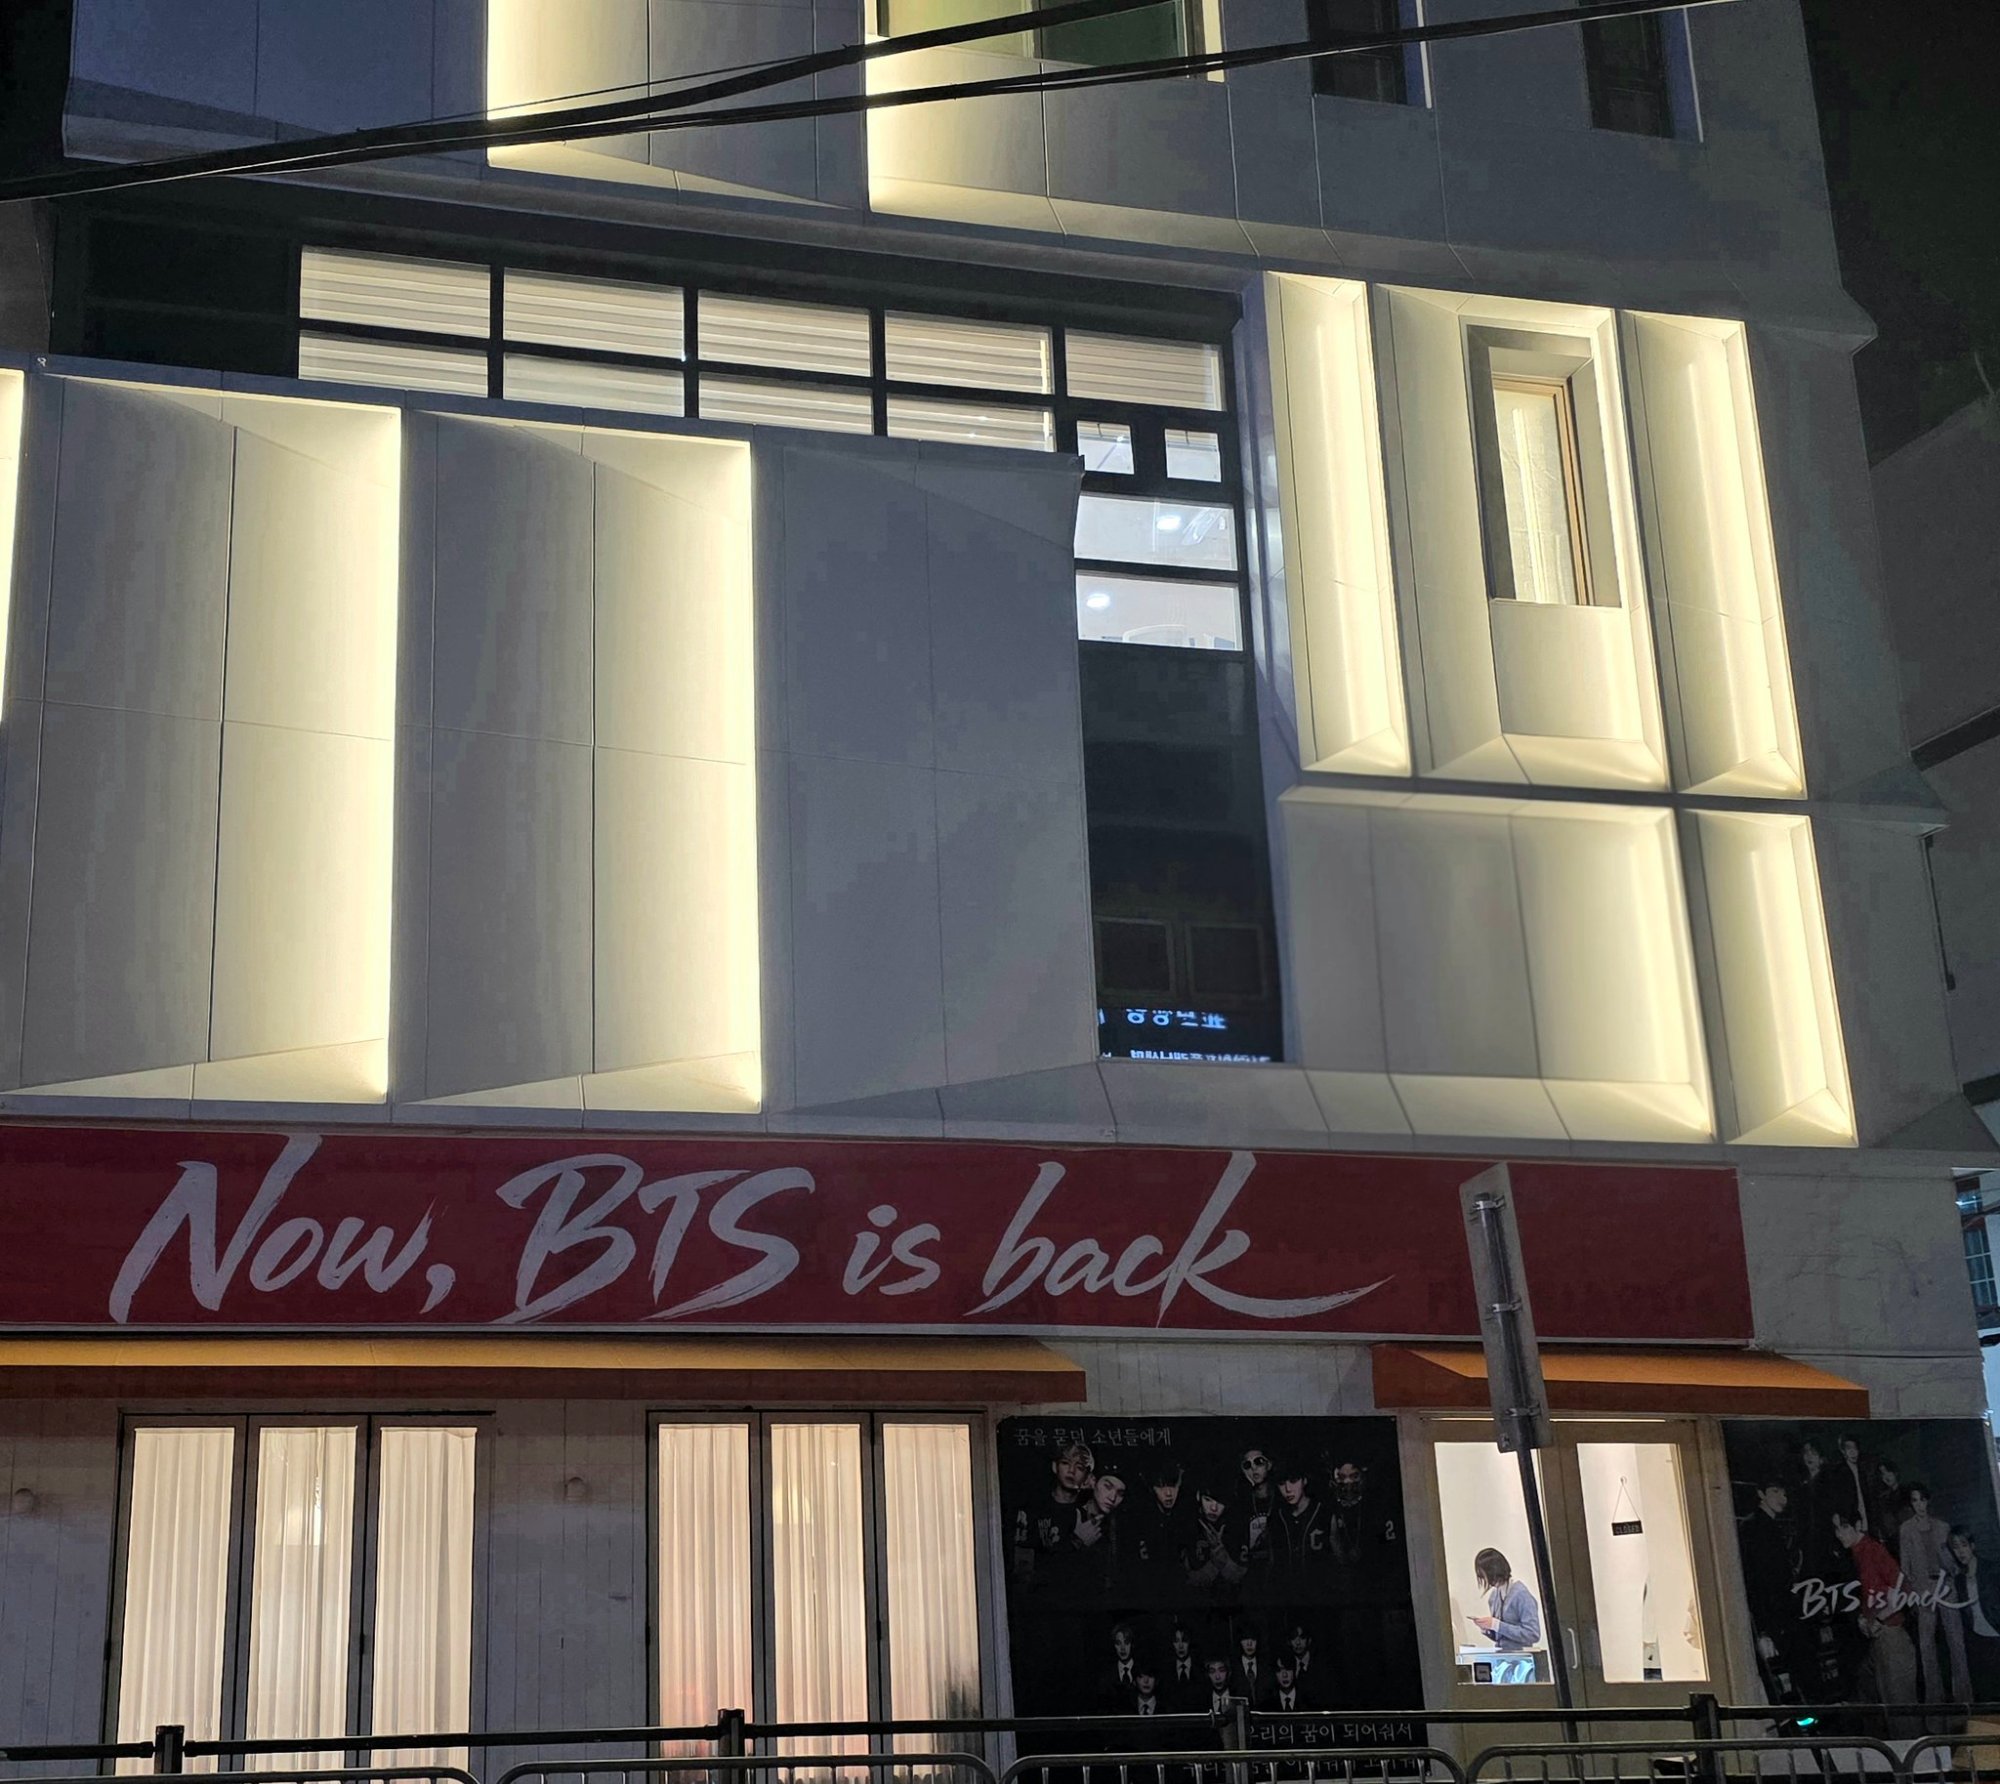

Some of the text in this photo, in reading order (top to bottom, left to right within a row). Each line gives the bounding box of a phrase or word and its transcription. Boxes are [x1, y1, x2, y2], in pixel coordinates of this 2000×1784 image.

[107, 1134, 1395, 1327] Now, BTS is back
[1015, 1427, 1048, 1447] 꿈을
[1091, 1427, 1172, 1447] 소년들에게
[1790, 1568, 1979, 1621] BTS is back
[1300, 1722, 1335, 1744] 꿈이
